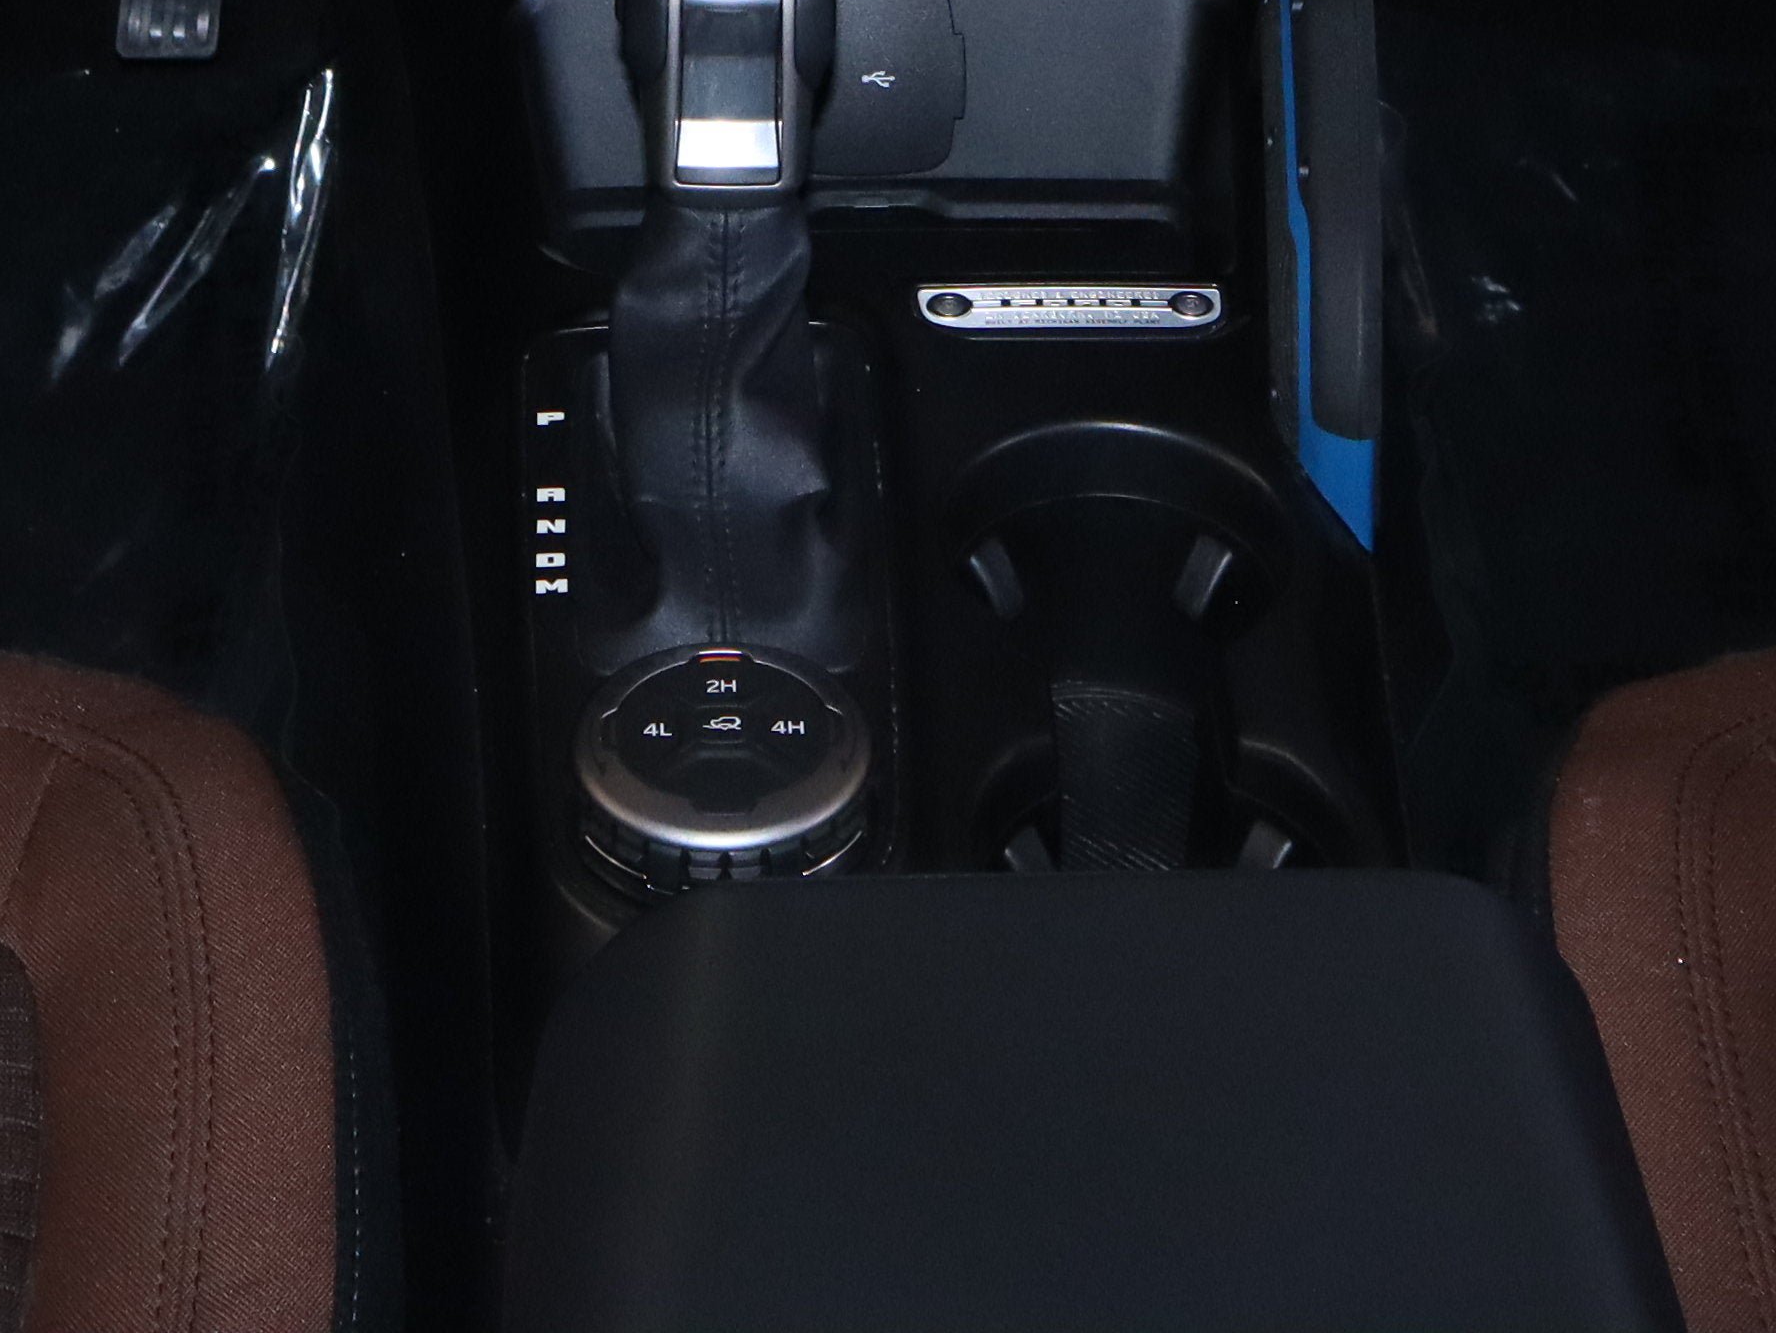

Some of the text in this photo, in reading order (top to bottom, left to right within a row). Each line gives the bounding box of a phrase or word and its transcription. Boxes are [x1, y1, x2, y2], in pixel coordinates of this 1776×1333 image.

[536, 411, 565, 426] P
[536, 518, 566, 534] N
[535, 552, 566, 568] D
[535, 578, 569, 594] M
[706, 679, 737, 693] 2H
[643, 722, 673, 737] 4L
[770, 720, 805, 735] 4H
